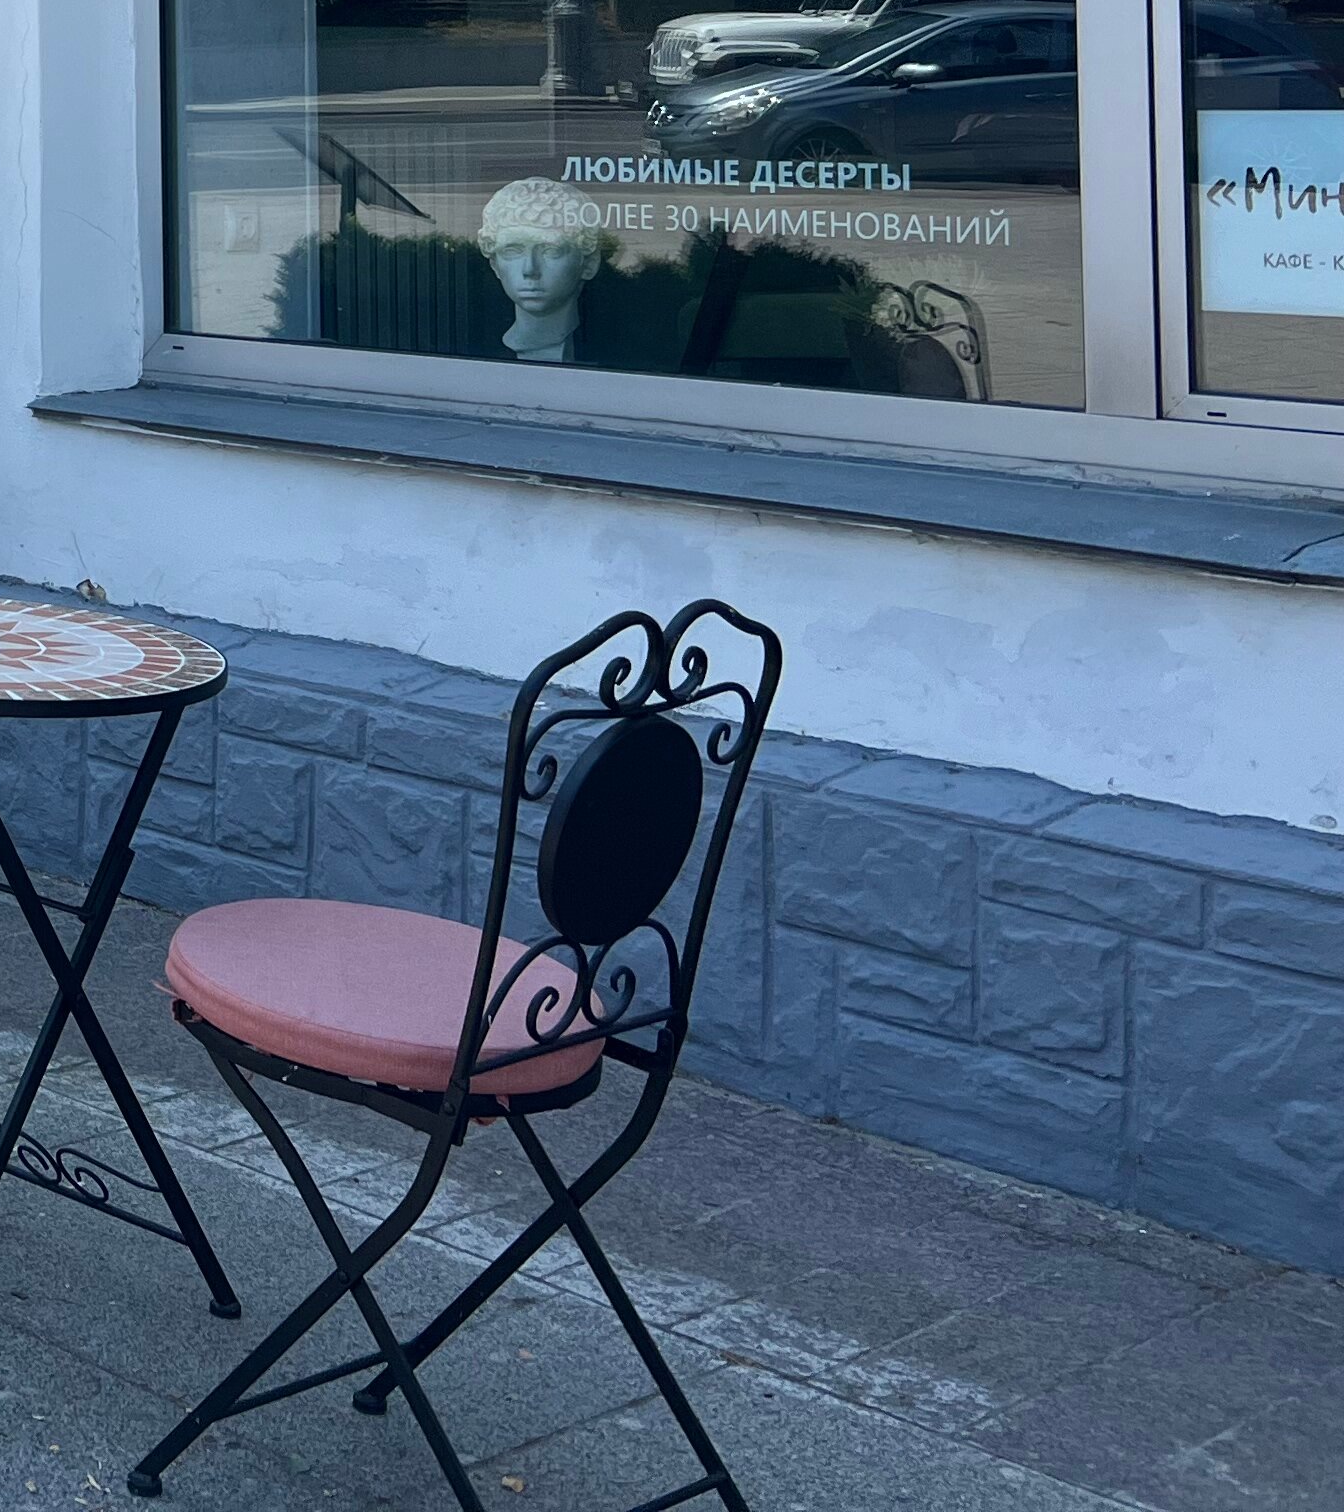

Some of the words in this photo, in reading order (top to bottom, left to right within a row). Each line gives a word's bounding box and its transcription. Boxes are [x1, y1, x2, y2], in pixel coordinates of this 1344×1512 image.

[560, 155, 739, 187] ЛЮБИМЫЕ
[749, 159, 911, 193] ДЕСЕРТЫ
[563, 201, 654, 231] БОЛЕЕ
[665, 204, 698, 232] 30
[709, 207, 1011, 246] НАИМЕНОВАНИЙ
[1264, 252, 1313, 270] КАФЕ
